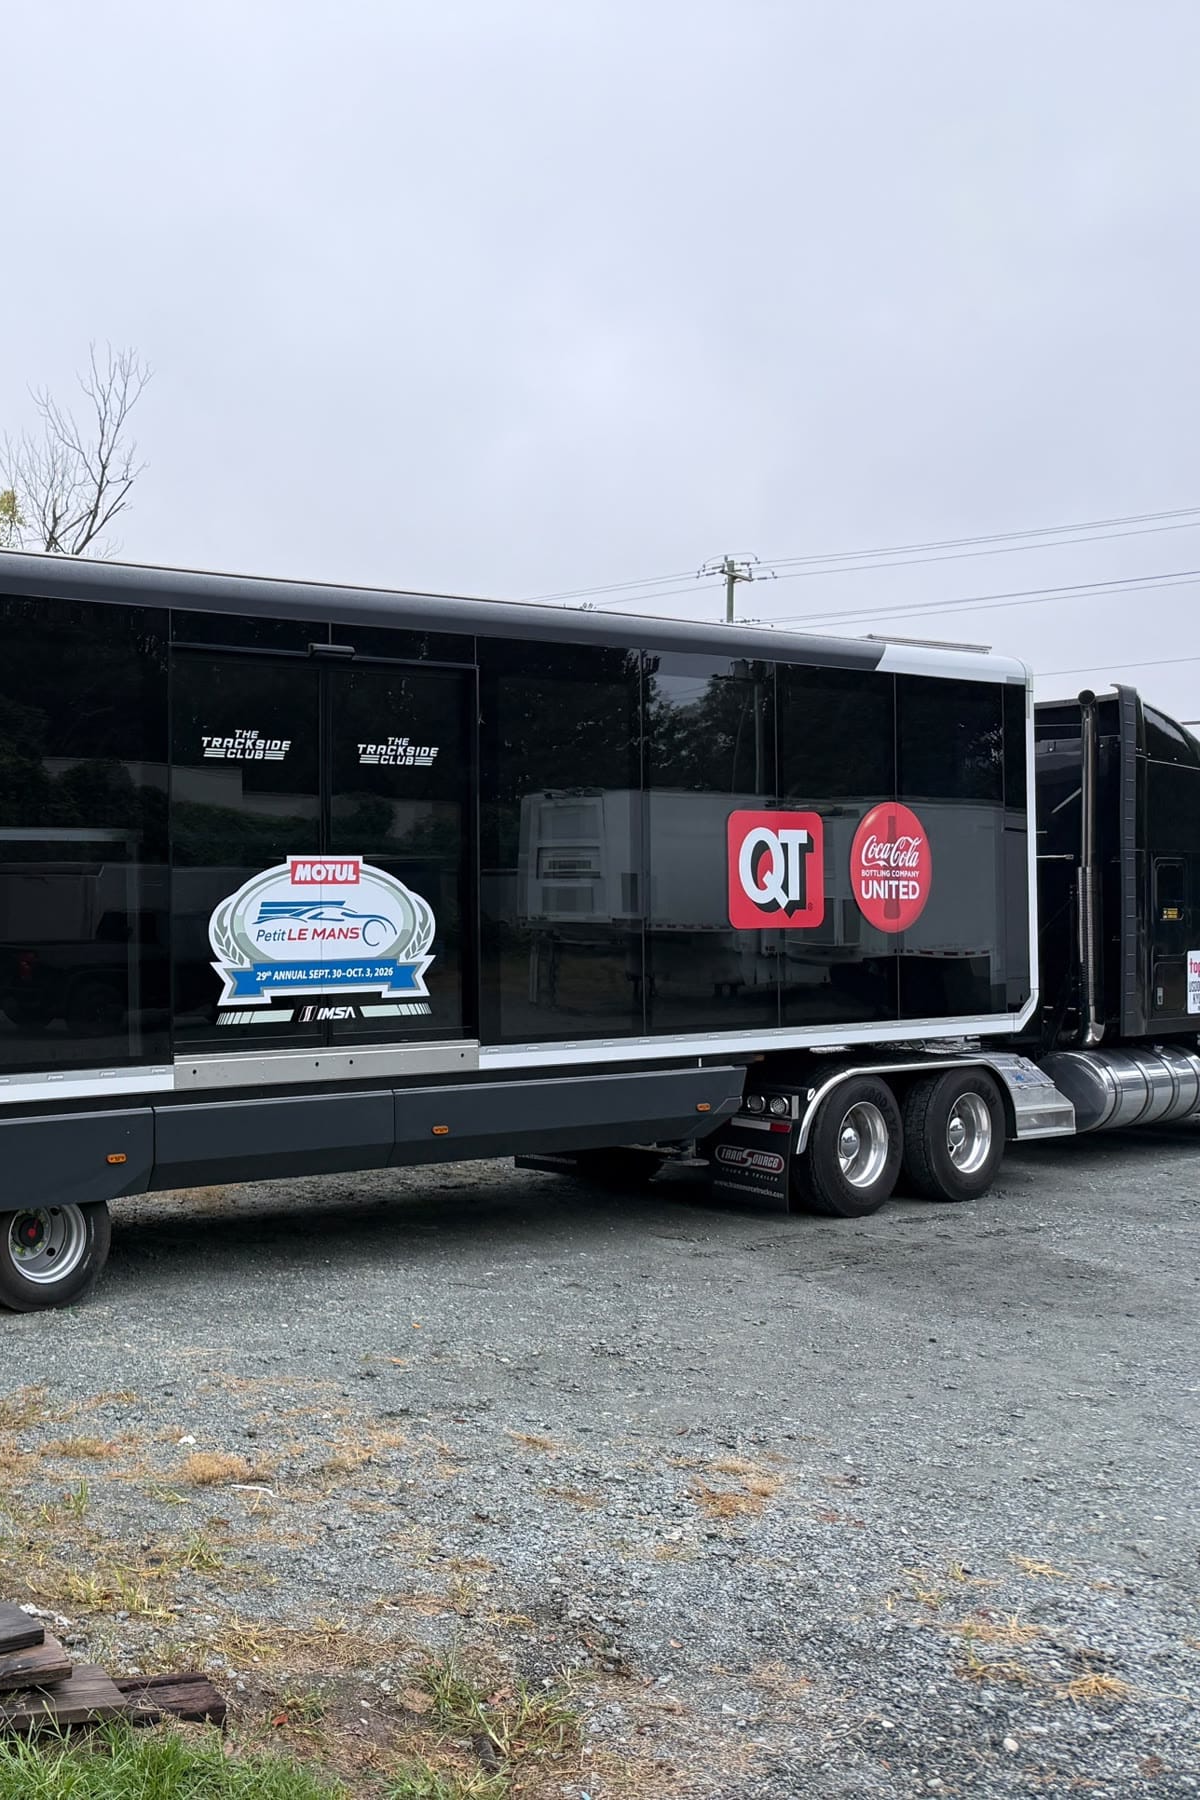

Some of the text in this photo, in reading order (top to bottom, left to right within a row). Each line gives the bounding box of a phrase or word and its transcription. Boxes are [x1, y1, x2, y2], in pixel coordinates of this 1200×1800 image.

[234, 729, 260, 739] THE
[387, 736, 410, 746] THE
[201, 736, 292, 751] TRACKSIDE
[357, 743, 440, 758] TRACKSIDE
[226, 748, 265, 760] CLUB
[380, 755, 415, 766] CLUB
[861, 834, 922, 868] Coca-Cola
[294, 863, 358, 882] MOTUL
[738, 826, 811, 911] QT
[861, 869, 920, 878] BOTTLING COMPANY
[861, 879, 921, 900] UNITED
[255, 927, 360, 942] Petit LE MANS
[255, 970, 272, 982] 29th
[273, 970, 308, 981] ANNUAL
[308, 969, 331, 980] SEPT.
[365, 968, 373, 979] 3,
[374, 966, 394, 977] 2026
[316, 1006, 357, 1020] IMSA
